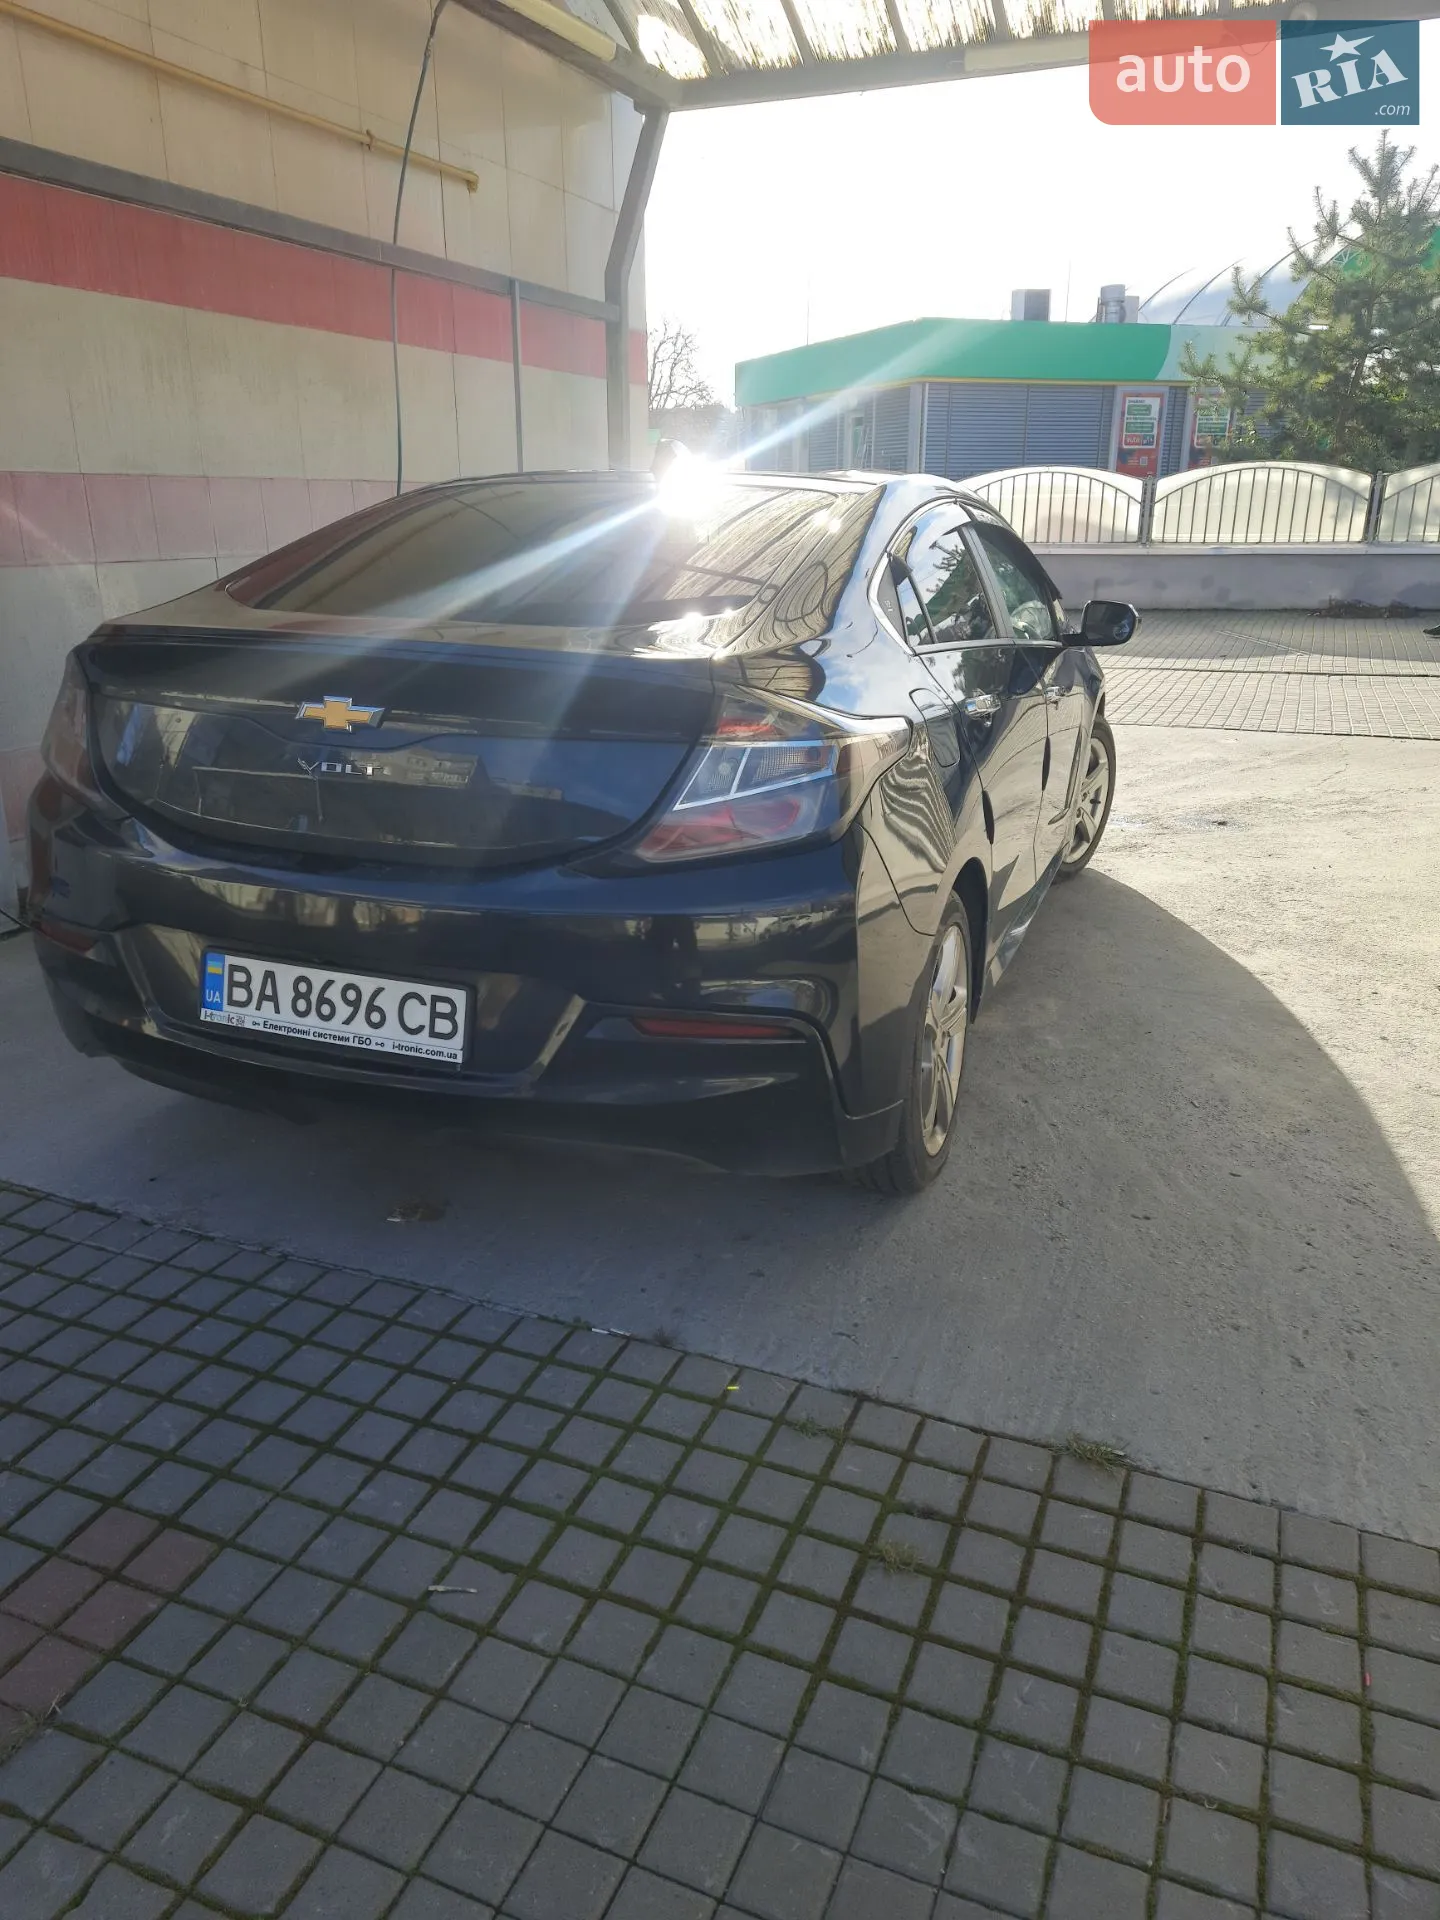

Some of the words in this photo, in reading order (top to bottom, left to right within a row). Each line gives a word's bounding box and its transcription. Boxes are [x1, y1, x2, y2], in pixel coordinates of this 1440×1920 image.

[297, 758, 383, 778] VOLT
[205, 989, 221, 1004] UA
[290, 975, 387, 1030] 8696
[262, 1020, 311, 1038] Електронні
[312, 1029, 350, 1044] системи
[352, 1035, 372, 1047] ГБО
[392, 1042, 458, 1060] i-tronic.com.ua
